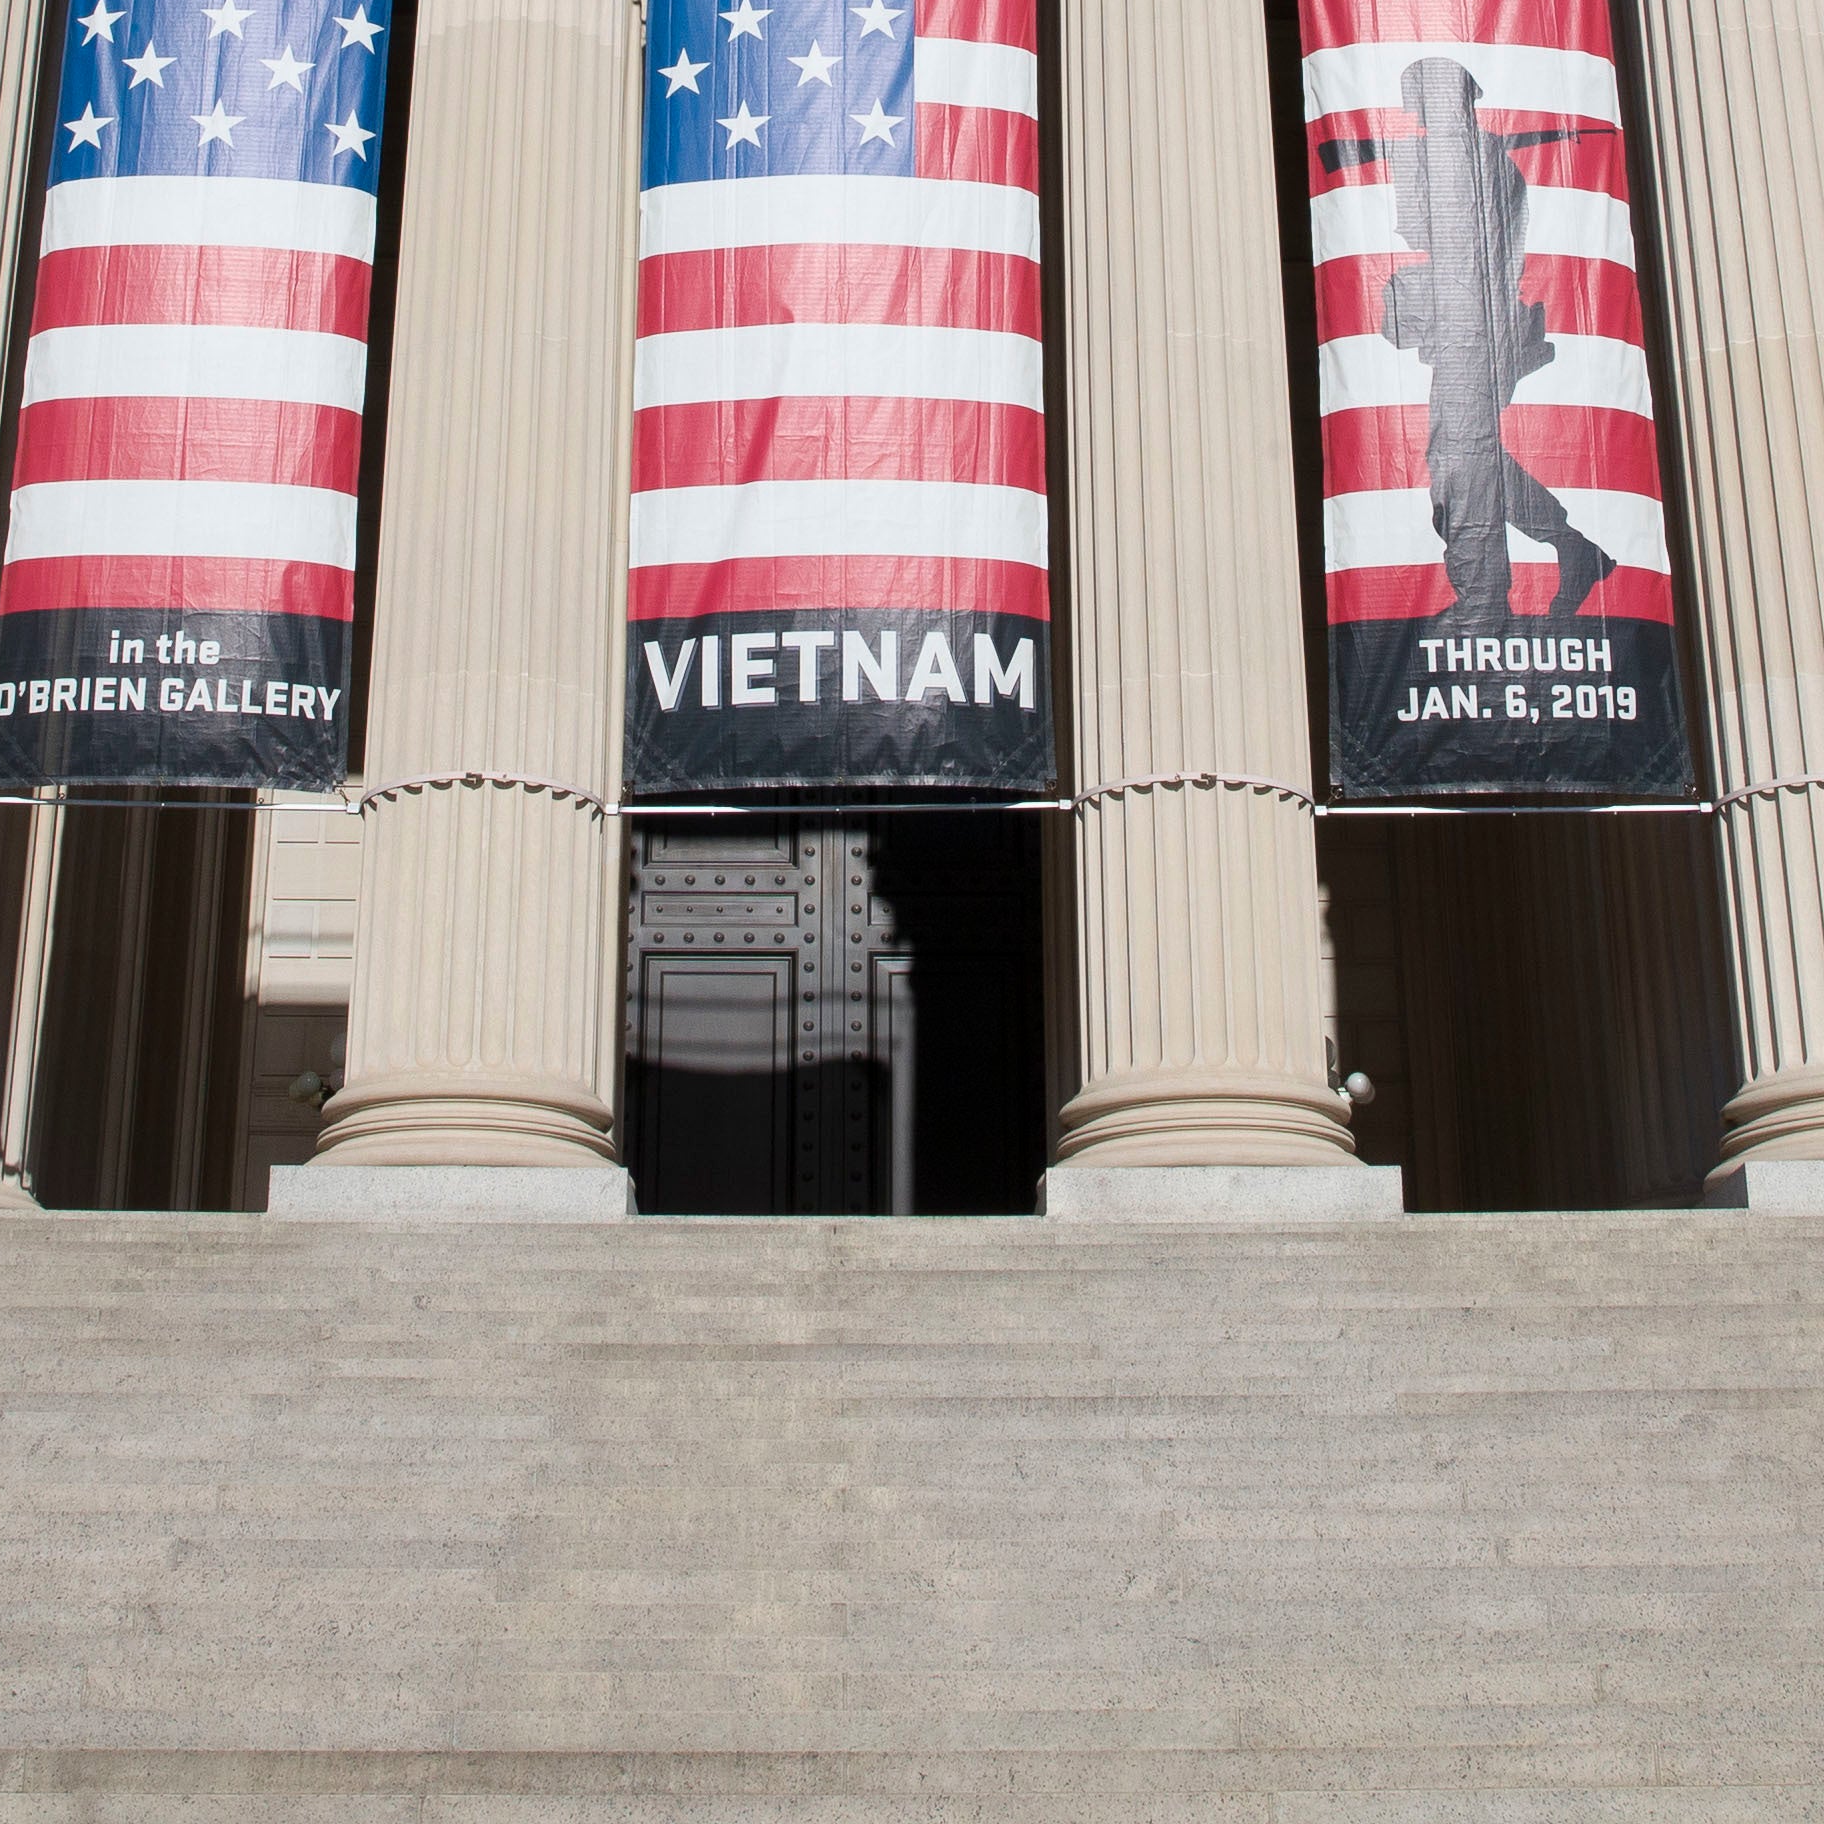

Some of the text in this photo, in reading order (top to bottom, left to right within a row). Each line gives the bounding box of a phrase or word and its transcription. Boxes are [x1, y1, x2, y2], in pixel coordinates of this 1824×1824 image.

[109, 630, 220, 664] in the
[1419, 637, 1612, 673] THROUGH
[643, 630, 1037, 713] VIETNAM
[159, 677, 341, 721] GALLERY
[1397, 684, 1637, 724] JAN. 6, 2019
